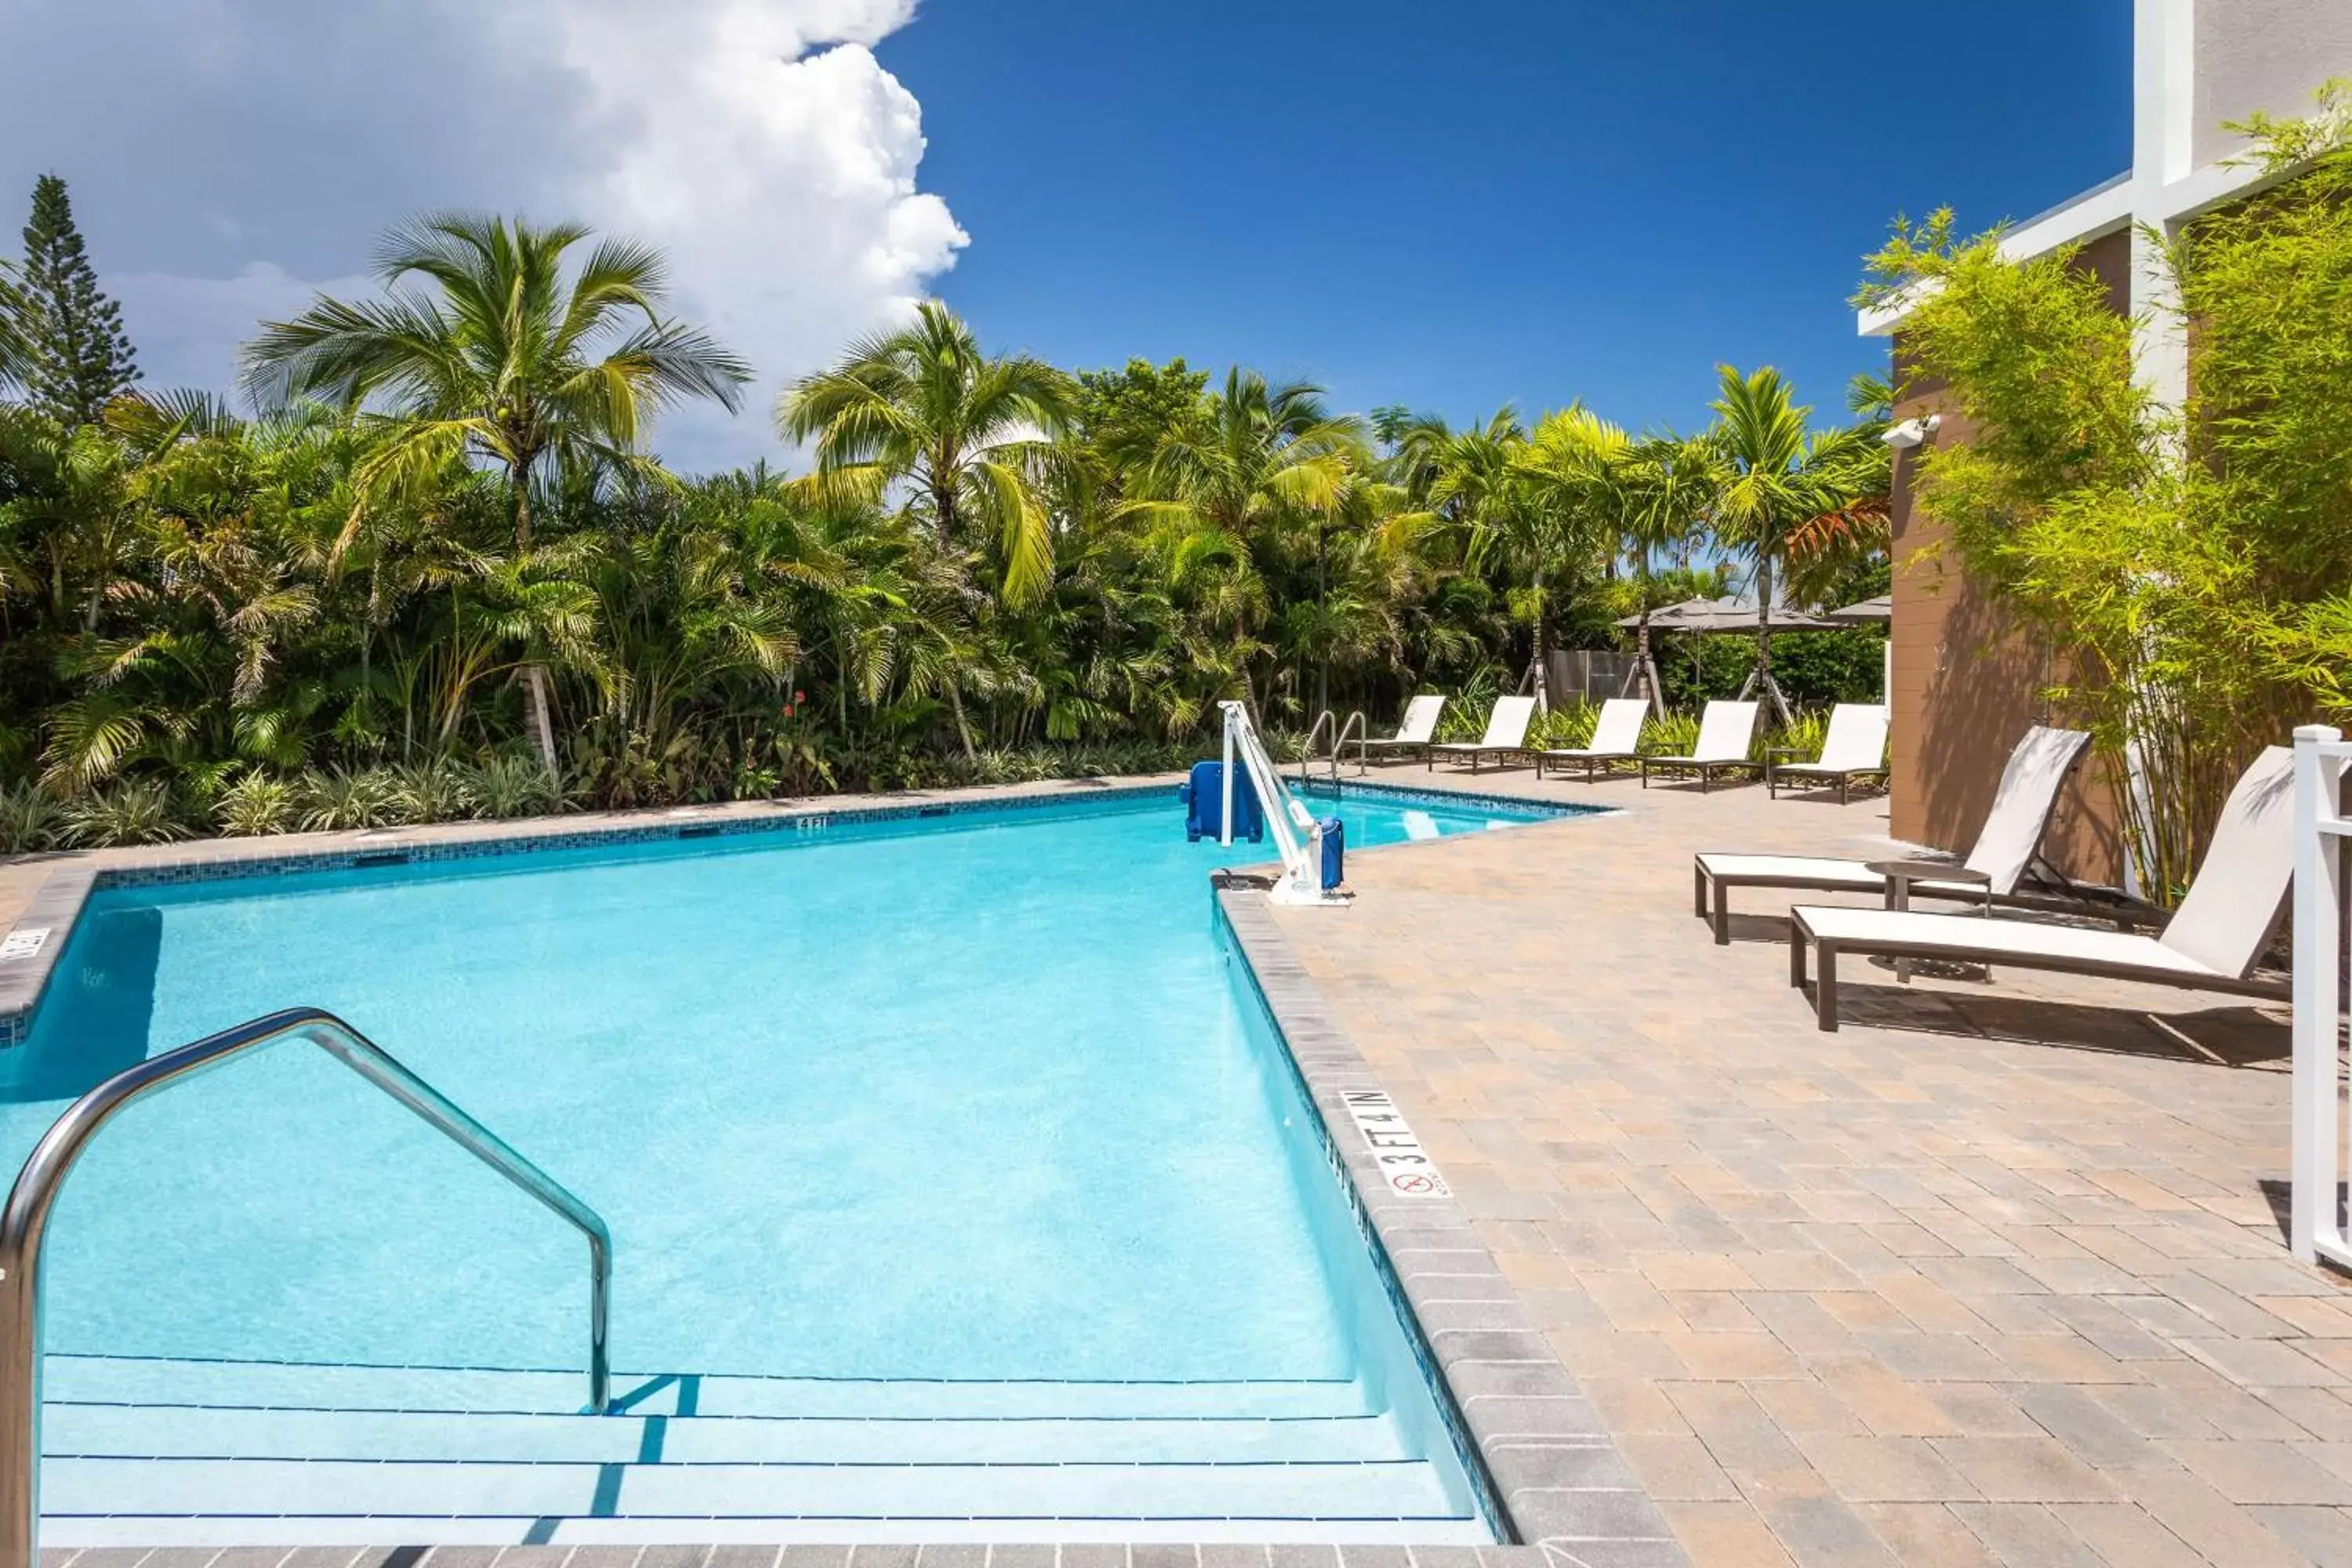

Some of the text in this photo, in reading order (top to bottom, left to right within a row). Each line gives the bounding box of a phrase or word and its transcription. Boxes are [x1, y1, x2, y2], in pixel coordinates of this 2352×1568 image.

[800, 818, 808, 827] 4
[1344, 1092, 1427, 1164] 3 FT 4 IN
